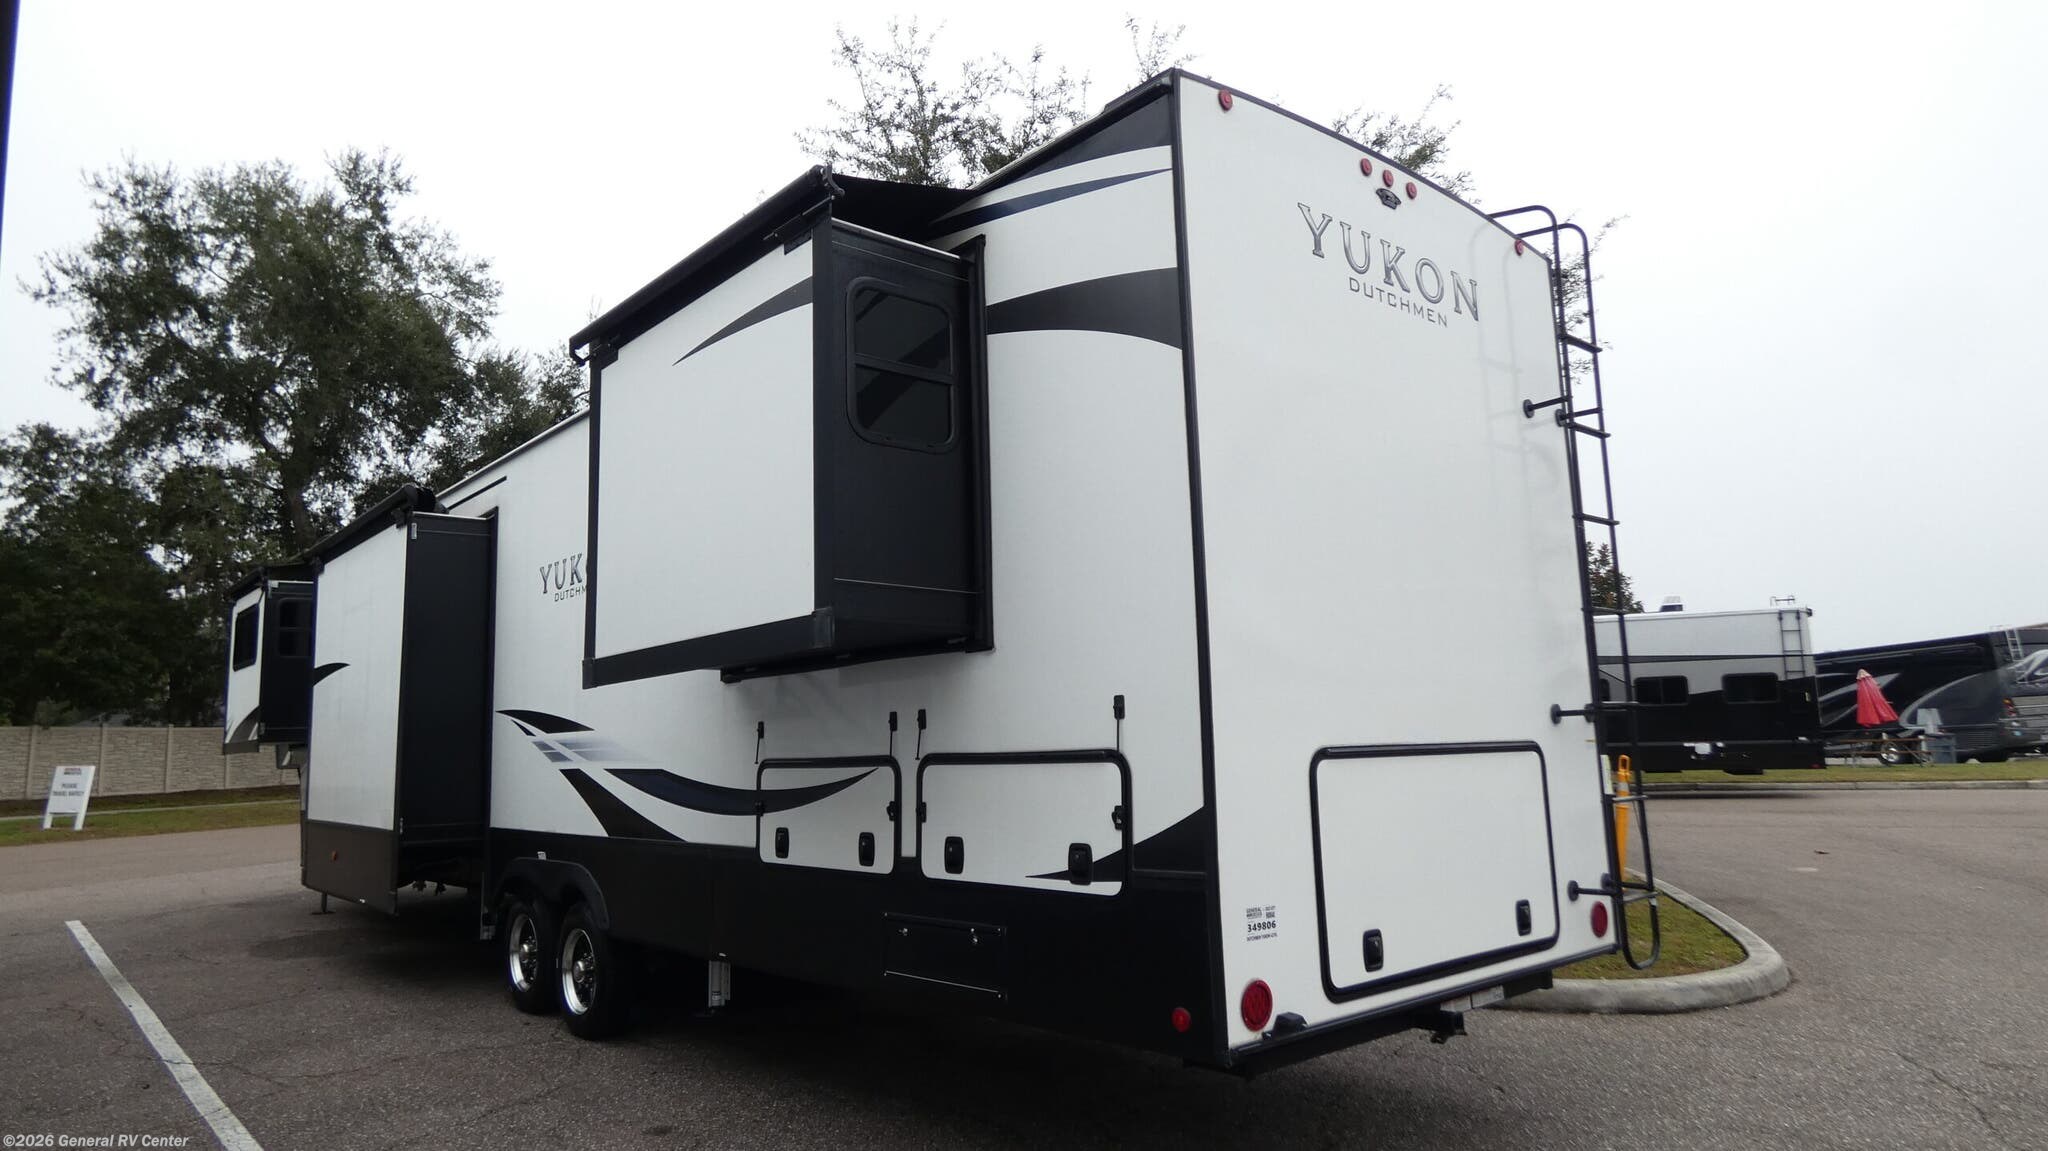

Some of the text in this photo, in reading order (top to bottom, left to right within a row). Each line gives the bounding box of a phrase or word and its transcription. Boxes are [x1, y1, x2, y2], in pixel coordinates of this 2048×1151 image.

[1297, 202, 1479, 322] YUKON
[1349, 276, 1448, 328] DUTCHMEN
[539, 553, 582, 594] YUK
[554, 585, 587, 602] DUTCHM
[1247, 920, 1276, 932] 349806
